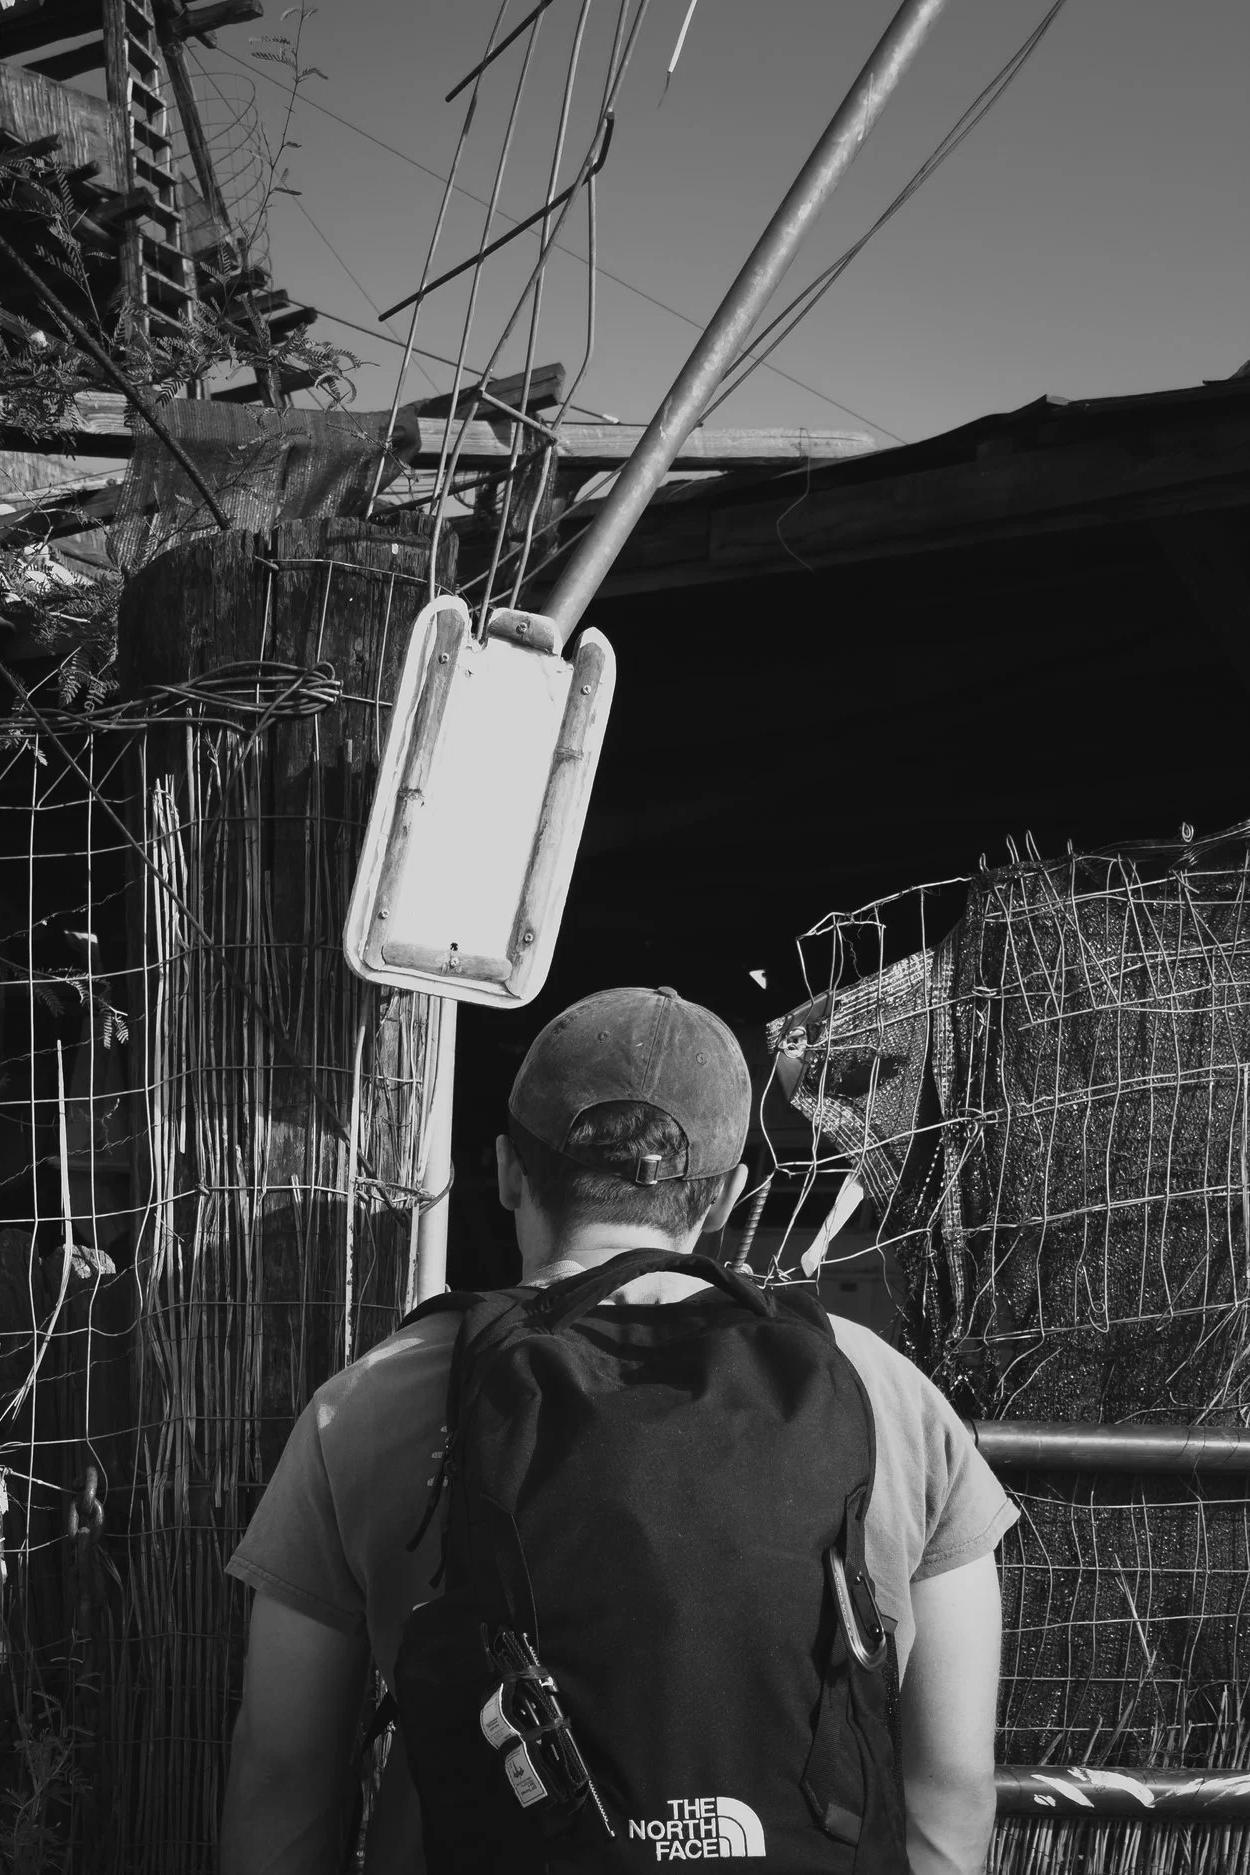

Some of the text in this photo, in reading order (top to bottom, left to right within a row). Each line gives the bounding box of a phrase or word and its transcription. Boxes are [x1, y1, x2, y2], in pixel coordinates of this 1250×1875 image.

[667, 1798, 716, 1820] THE
[628, 1818, 717, 1840] NORTH
[656, 1838, 719, 1861] FACE
